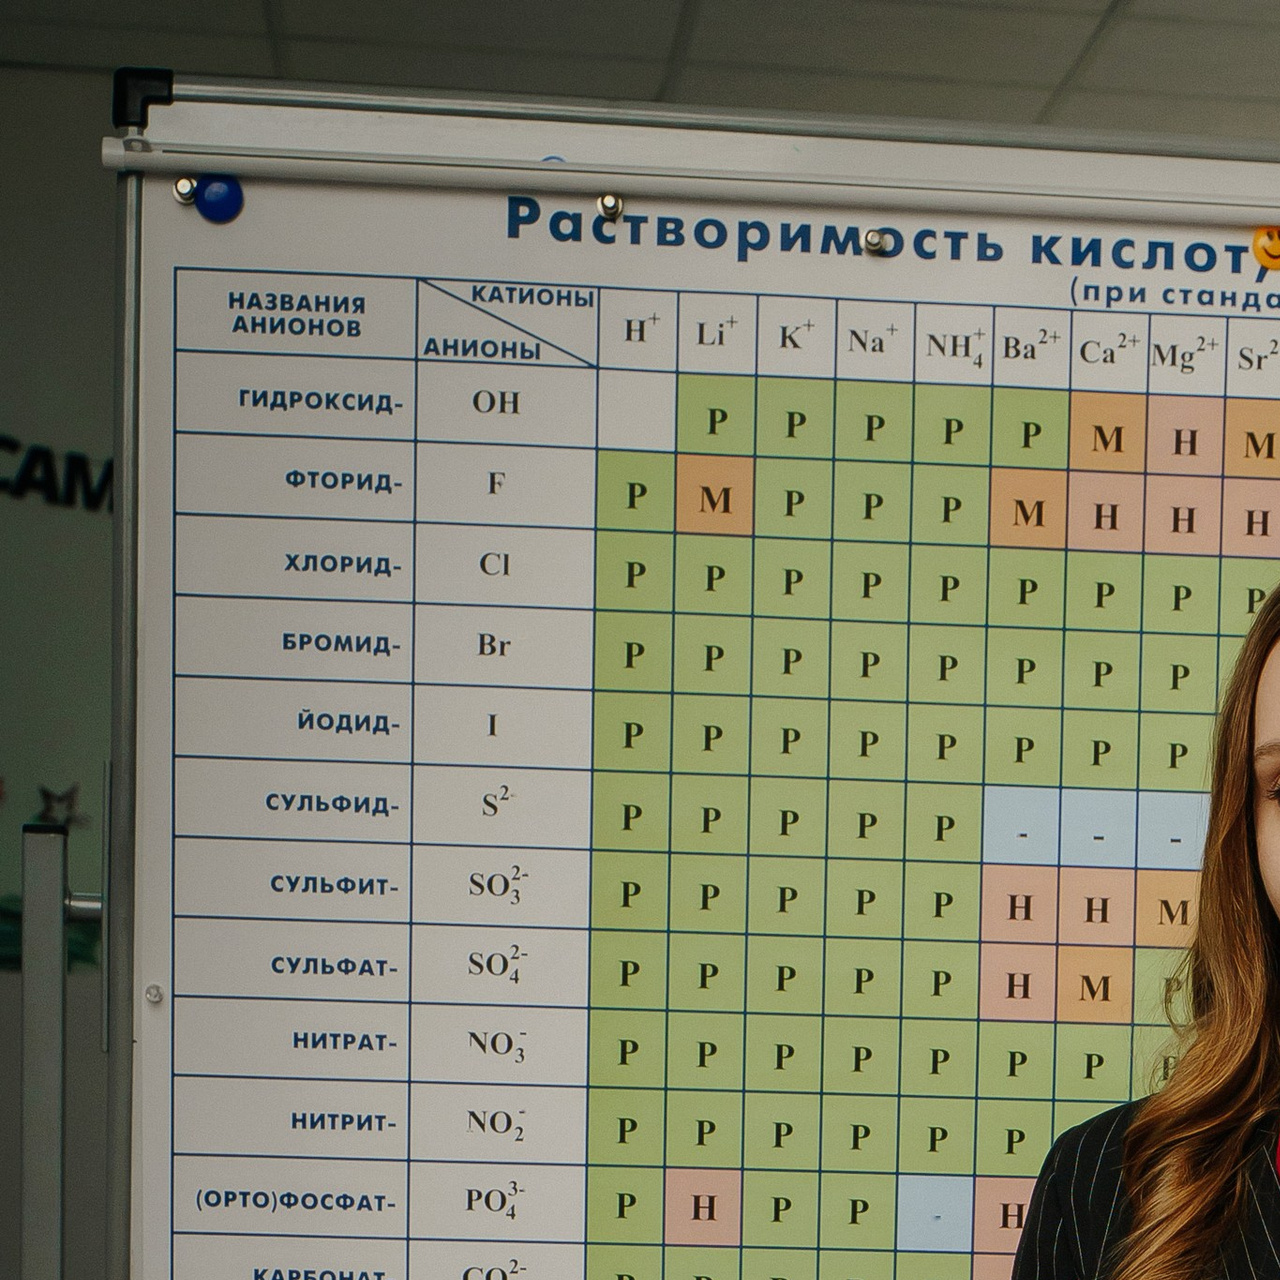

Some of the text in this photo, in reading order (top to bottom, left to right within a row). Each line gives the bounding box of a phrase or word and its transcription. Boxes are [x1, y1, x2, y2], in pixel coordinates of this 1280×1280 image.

[506, 195, 1005, 263] Растворимость
[228, 291, 366, 315] НАЗВАНИЯ
[471, 284, 594, 308] КАТИОНЫ
[1070, 275, 1147, 309] (при
[231, 314, 362, 338] АНИОНОВ
[422, 337, 541, 361] АНИОНЫ
[624, 312, 661, 343] H+
[696, 315, 738, 346] Li+
[779, 318, 815, 350] K+
[848, 323, 899, 354] Na+
[1002, 328, 1062, 360] Ba2+
[1079, 332, 1141, 365] Ca2+
[1151, 335, 1220, 375] Mg2+
[239, 388, 404, 416] ГИДРОКСИД-
[472, 389, 521, 415] OH
[707, 407, 729, 436] Р
[785, 410, 807, 439] Р
[864, 414, 886, 442] Р
[943, 417, 964, 446] Р
[1020, 421, 1042, 449] Р
[1091, 424, 1125, 454] М
[1173, 428, 1199, 457] Н
[1243, 431, 1276, 460] М
[285, 469, 403, 495] ФТОРИД-
[488, 471, 506, 495] F
[626, 481, 648, 510] Р
[698, 485, 733, 515] М
[284, 553, 402, 578] ХЛОРИД-
[479, 552, 510, 577] Cl
[625, 560, 647, 589] Р
[282, 632, 401, 658] БРОМИД-
[477, 632, 512, 657] Br
[623, 641, 646, 669] Р
[298, 708, 401, 736] ЙОДИД-
[487, 713, 498, 738] I
[265, 792, 400, 818] СУЛЬФИД-
[621, 803, 643, 832] Р
[270, 874, 399, 896] СУЛЬФИТ-
[271, 956, 398, 977] СУЛЬФАТ-
[619, 959, 641, 988] Р
[293, 1031, 398, 1052] НИТРАТ-
[291, 1111, 397, 1132] НИТРИТ-
[616, 1117, 638, 1145] Р
[196, 1188, 396, 1214] (ОРТО)ФОСФАТ-
[615, 1192, 637, 1220] Р
[690, 1194, 718, 1222] Н
